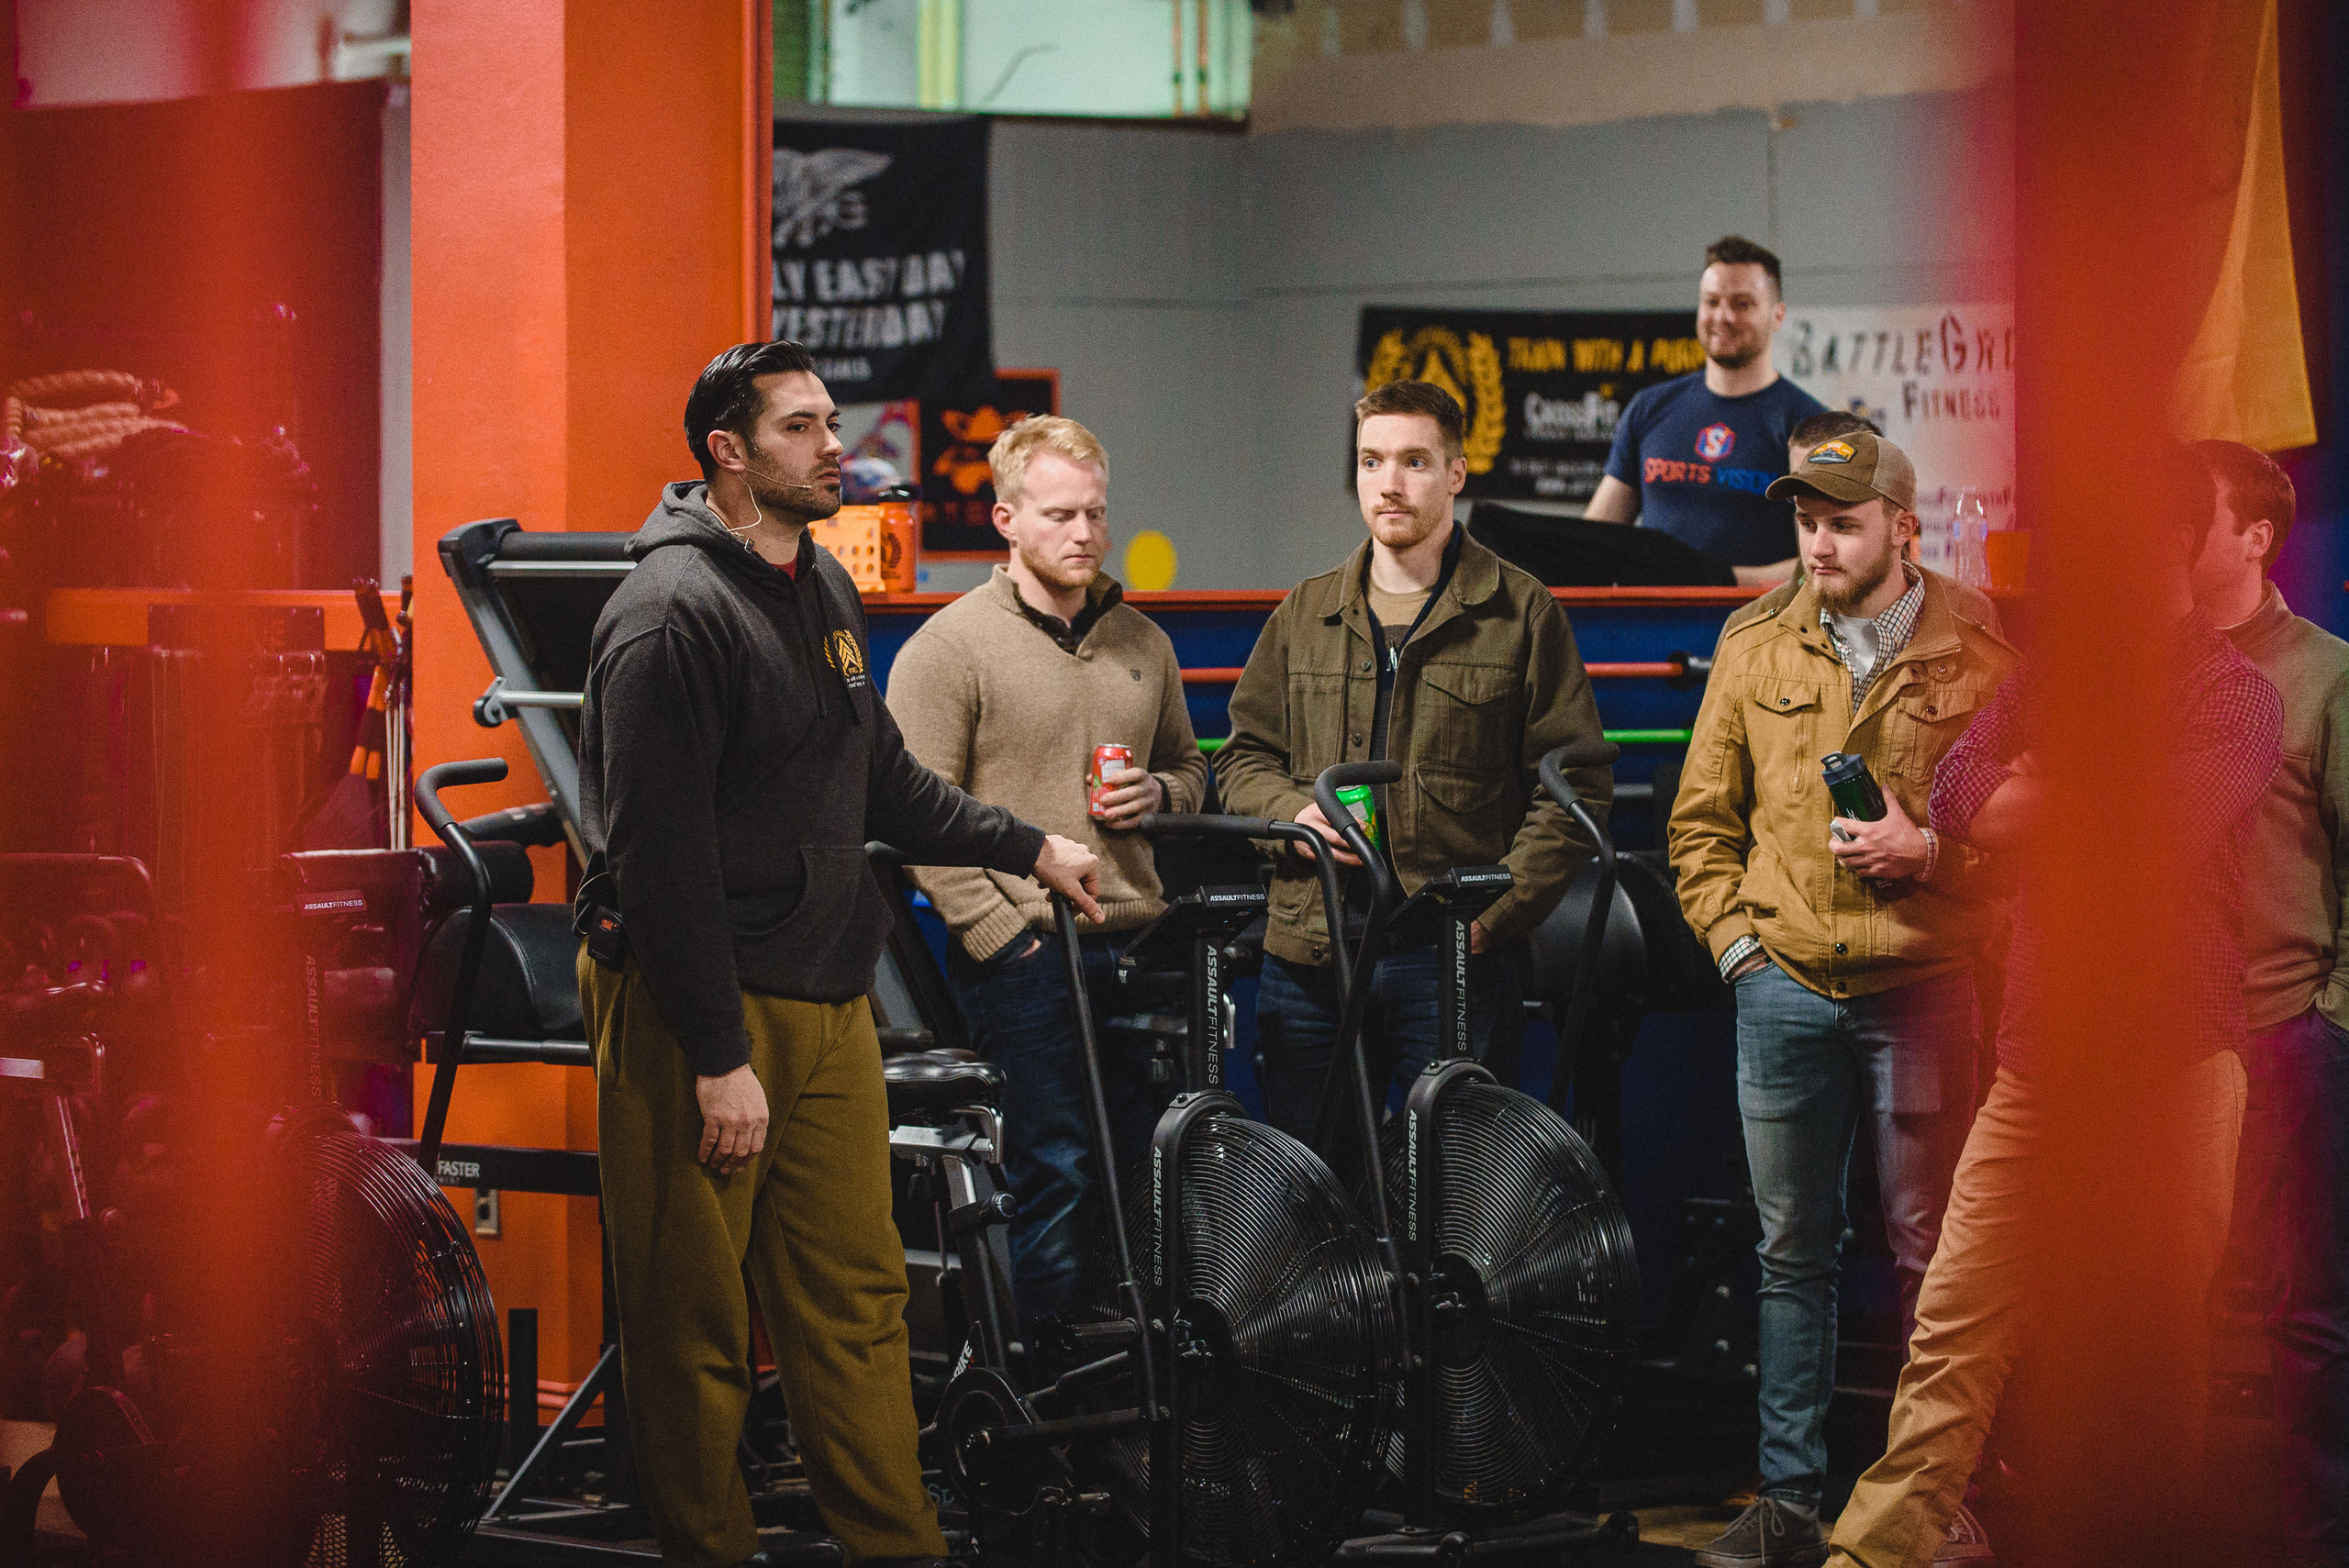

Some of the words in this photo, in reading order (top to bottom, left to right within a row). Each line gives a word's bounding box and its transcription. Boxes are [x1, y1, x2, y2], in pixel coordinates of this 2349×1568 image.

[1902, 380, 2000, 425] FITNESS
[1644, 457, 1711, 484] SPORTS
[438, 1161, 480, 1178] FASTER
